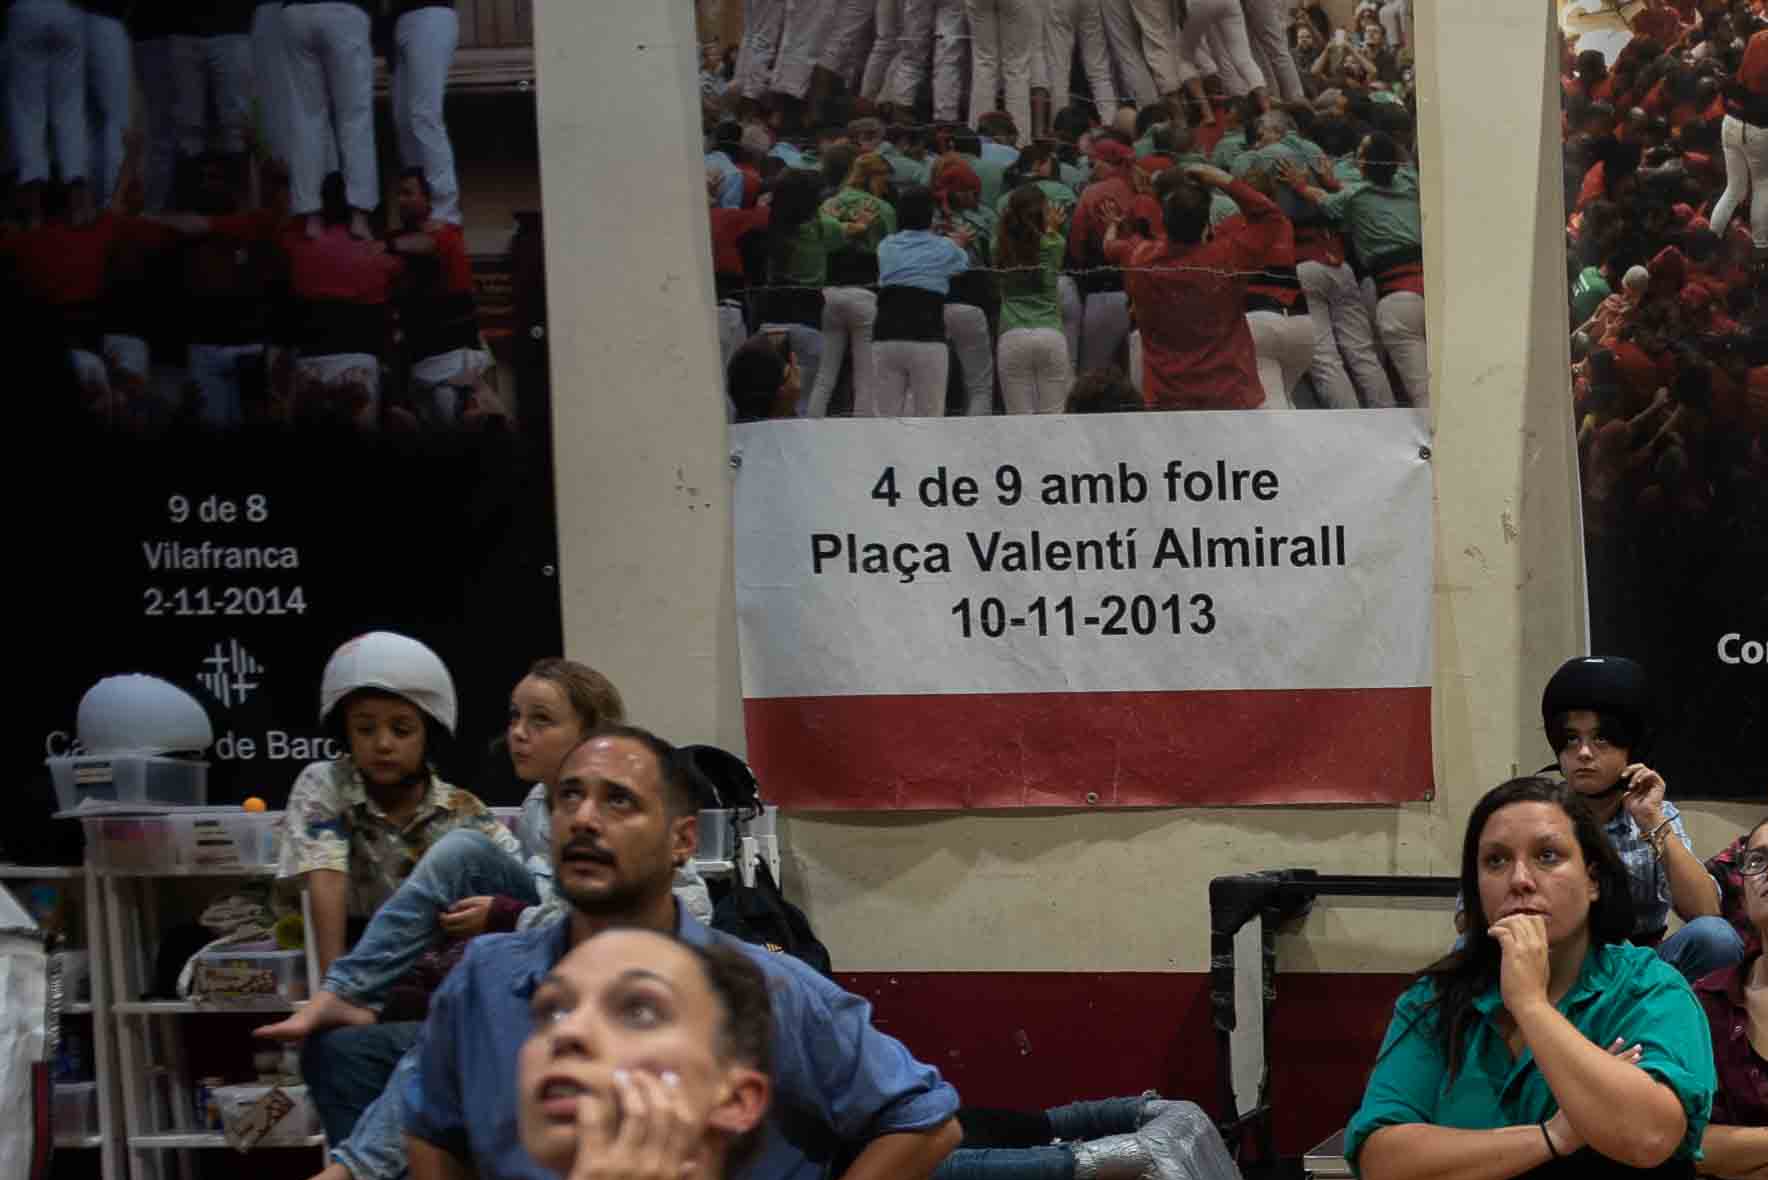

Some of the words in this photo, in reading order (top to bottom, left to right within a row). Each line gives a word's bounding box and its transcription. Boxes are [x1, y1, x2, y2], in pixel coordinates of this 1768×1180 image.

[871, 466, 901, 507] 4
[918, 466, 979, 507] de
[995, 464, 1023, 506] 9
[1041, 461, 1148, 506] amb
[1163, 459, 1280, 502] folre
[167, 495, 190, 523] 9
[199, 494, 237, 523] de
[246, 493, 269, 523] 8
[143, 540, 300, 569] Vilafranca
[810, 533, 951, 584] Plaça
[965, 527, 1137, 573] Valentí
[1151, 525, 1347, 569] Almirall
[143, 586, 308, 616] 2-11-2014
[951, 593, 1217, 638] 10-11-2013
[215, 730, 257, 760] de
